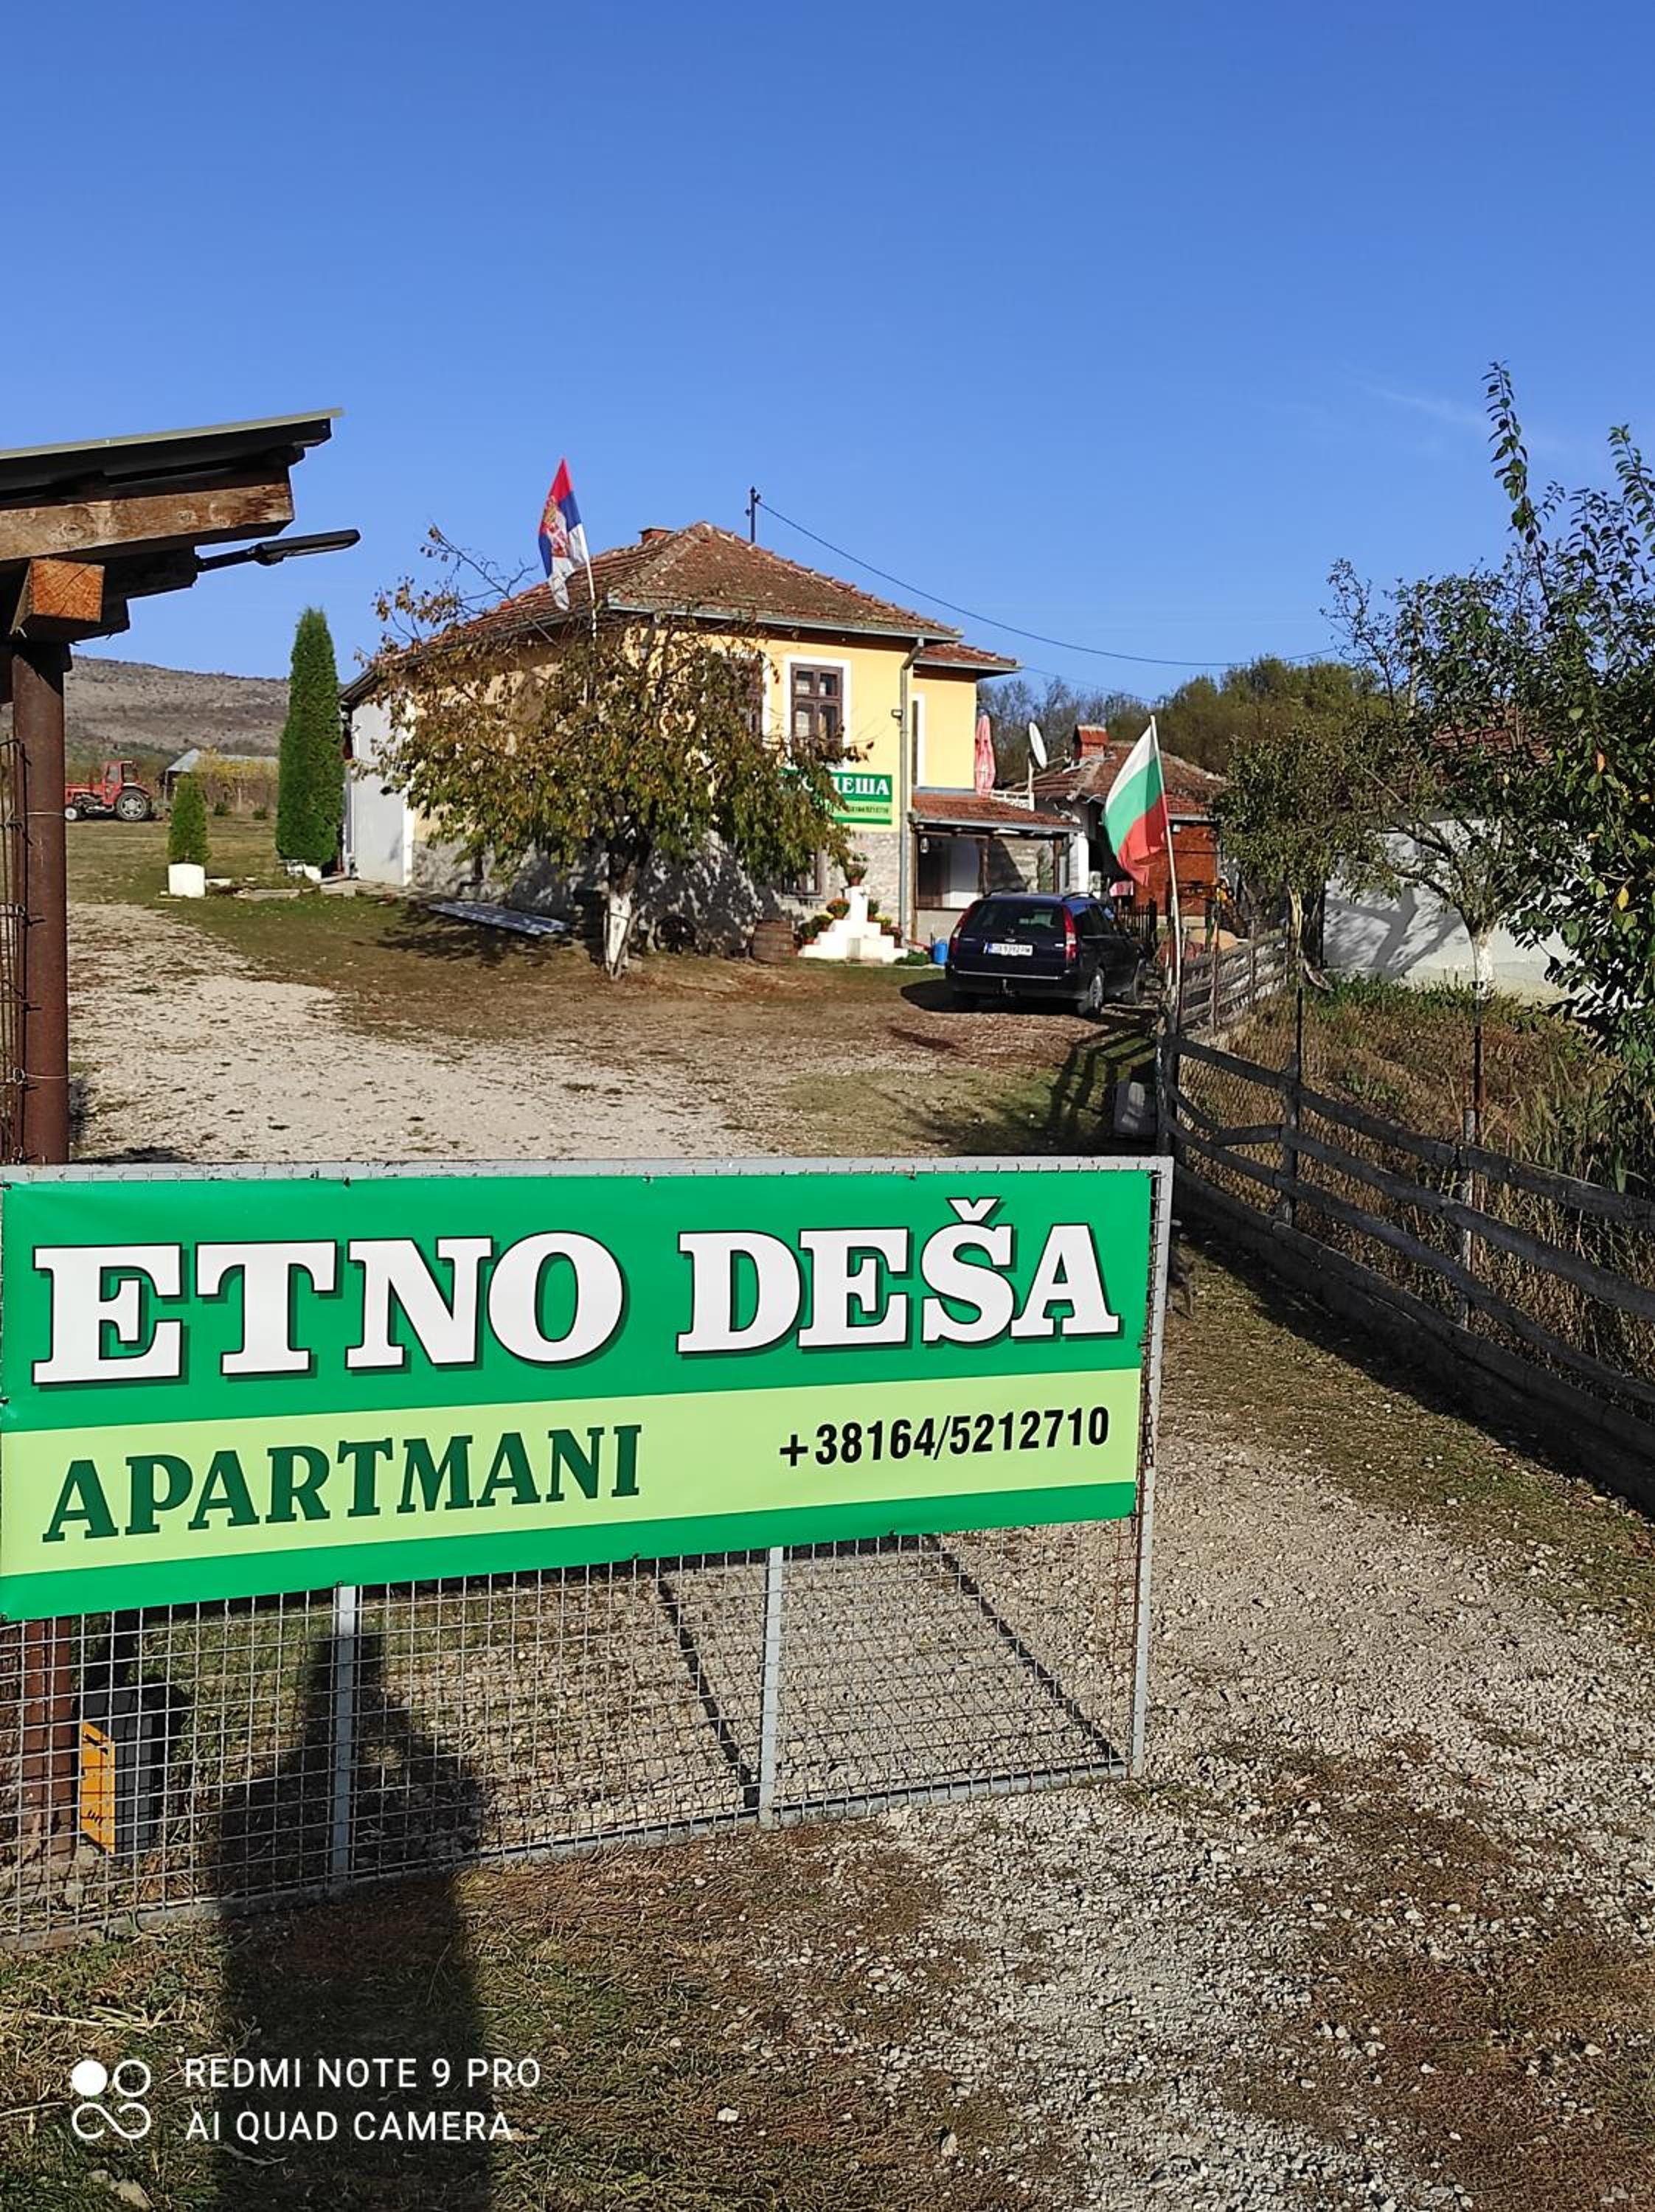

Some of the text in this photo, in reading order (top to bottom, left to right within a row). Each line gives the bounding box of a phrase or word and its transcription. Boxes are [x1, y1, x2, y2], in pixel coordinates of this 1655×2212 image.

[32, 1197, 1120, 1385] ETNO DEŠA
[42, 1425, 642, 1543] APARTMANI
[779, 1406, 1109, 1467] +38164/5212710
